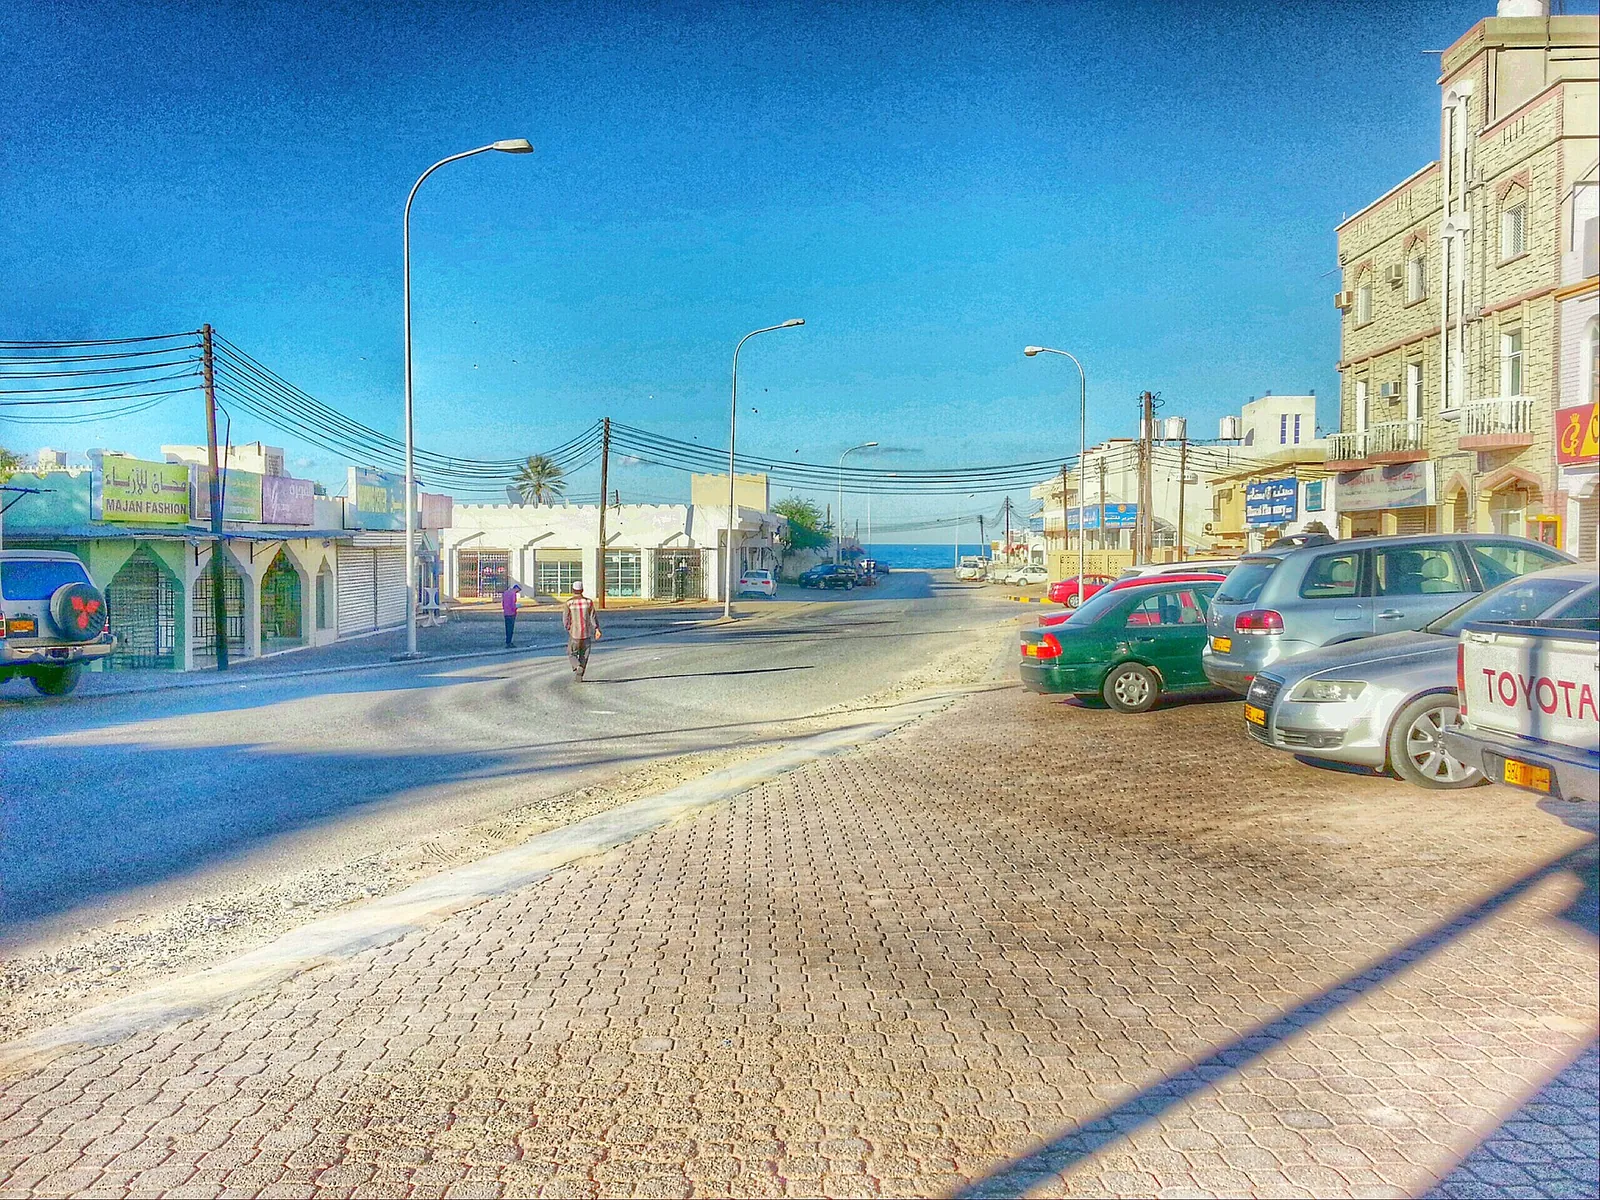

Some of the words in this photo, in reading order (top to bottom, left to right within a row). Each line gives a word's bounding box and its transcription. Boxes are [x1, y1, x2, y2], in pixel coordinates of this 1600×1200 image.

[152, 471, 186, 496] مجان
[106, 498, 143, 513] MAJAN
[145, 501, 187, 515] FASHION
[1482, 667, 1599, 722] TOYOTA
